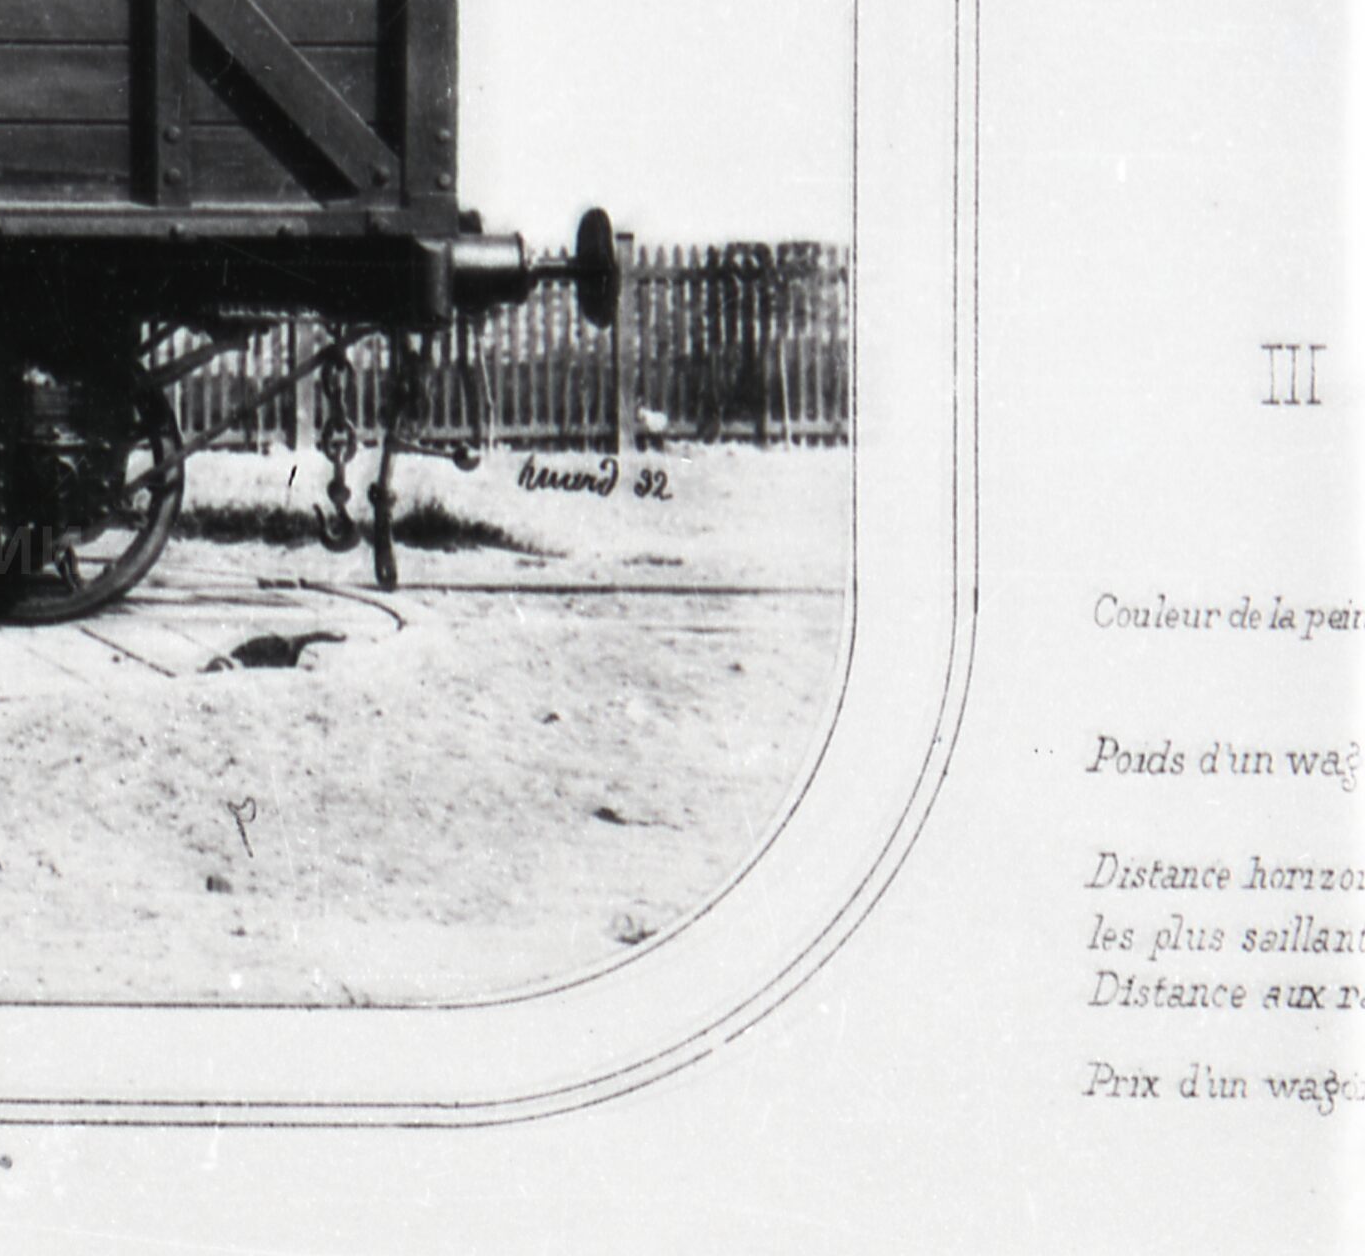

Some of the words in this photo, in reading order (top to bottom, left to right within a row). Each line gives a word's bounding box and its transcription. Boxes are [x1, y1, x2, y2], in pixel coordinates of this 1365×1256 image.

[1260, 343, 1328, 406] III
[1094, 592, 1222, 630] Couleur
[1229, 595, 1263, 631] de
[1268, 595, 1297, 631] la
[1086, 733, 1186, 776] Poids
[1199, 741, 1275, 776] d'un
[1083, 850, 1231, 892] Distance
[1086, 913, 1135, 952] les
[1146, 912, 1226, 963] plus
[1087, 969, 1248, 1011] Distance
[1262, 984, 1327, 1011] aux
[1081, 1060, 1161, 1099] Prix
[1179, 1061, 1249, 1100] d'un
